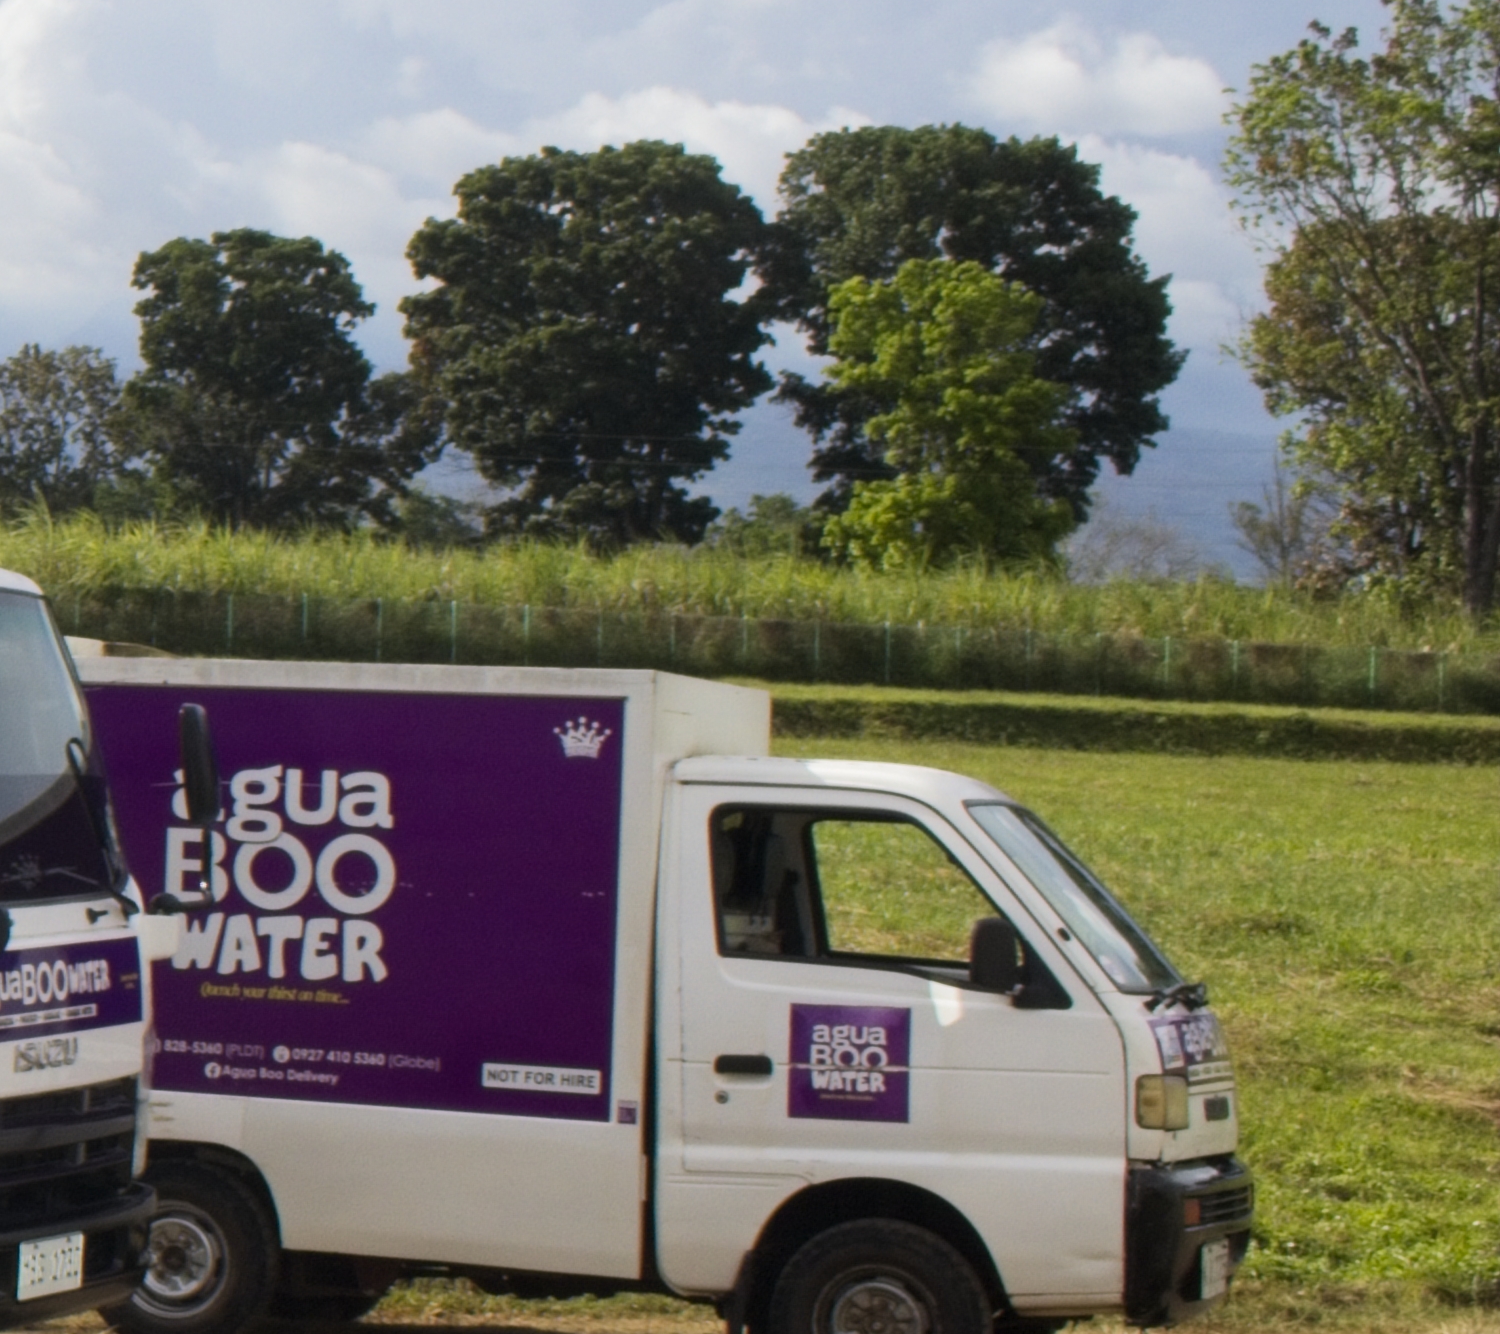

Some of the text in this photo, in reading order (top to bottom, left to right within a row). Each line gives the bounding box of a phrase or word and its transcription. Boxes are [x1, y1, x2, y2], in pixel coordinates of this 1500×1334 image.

[165, 827, 396, 915] BOO
[171, 912, 389, 983] WATER
[812, 1024, 887, 1050] agua
[14, 1036, 79, 1073] ISUZU
[164, 1039, 223, 1056] 828-5360
[291, 1049, 323, 1063] 0927
[327, 1051, 350, 1064] 410
[354, 1051, 385, 1067] 5360
[388, 1053, 440, 1072] (Globe)
[810, 1044, 889, 1070] BOO
[221, 1064, 339, 1087] Agua Boo Delivery
[486, 1069, 596, 1089] NOT FOR HIRE
[811, 1069, 886, 1093] WATER
